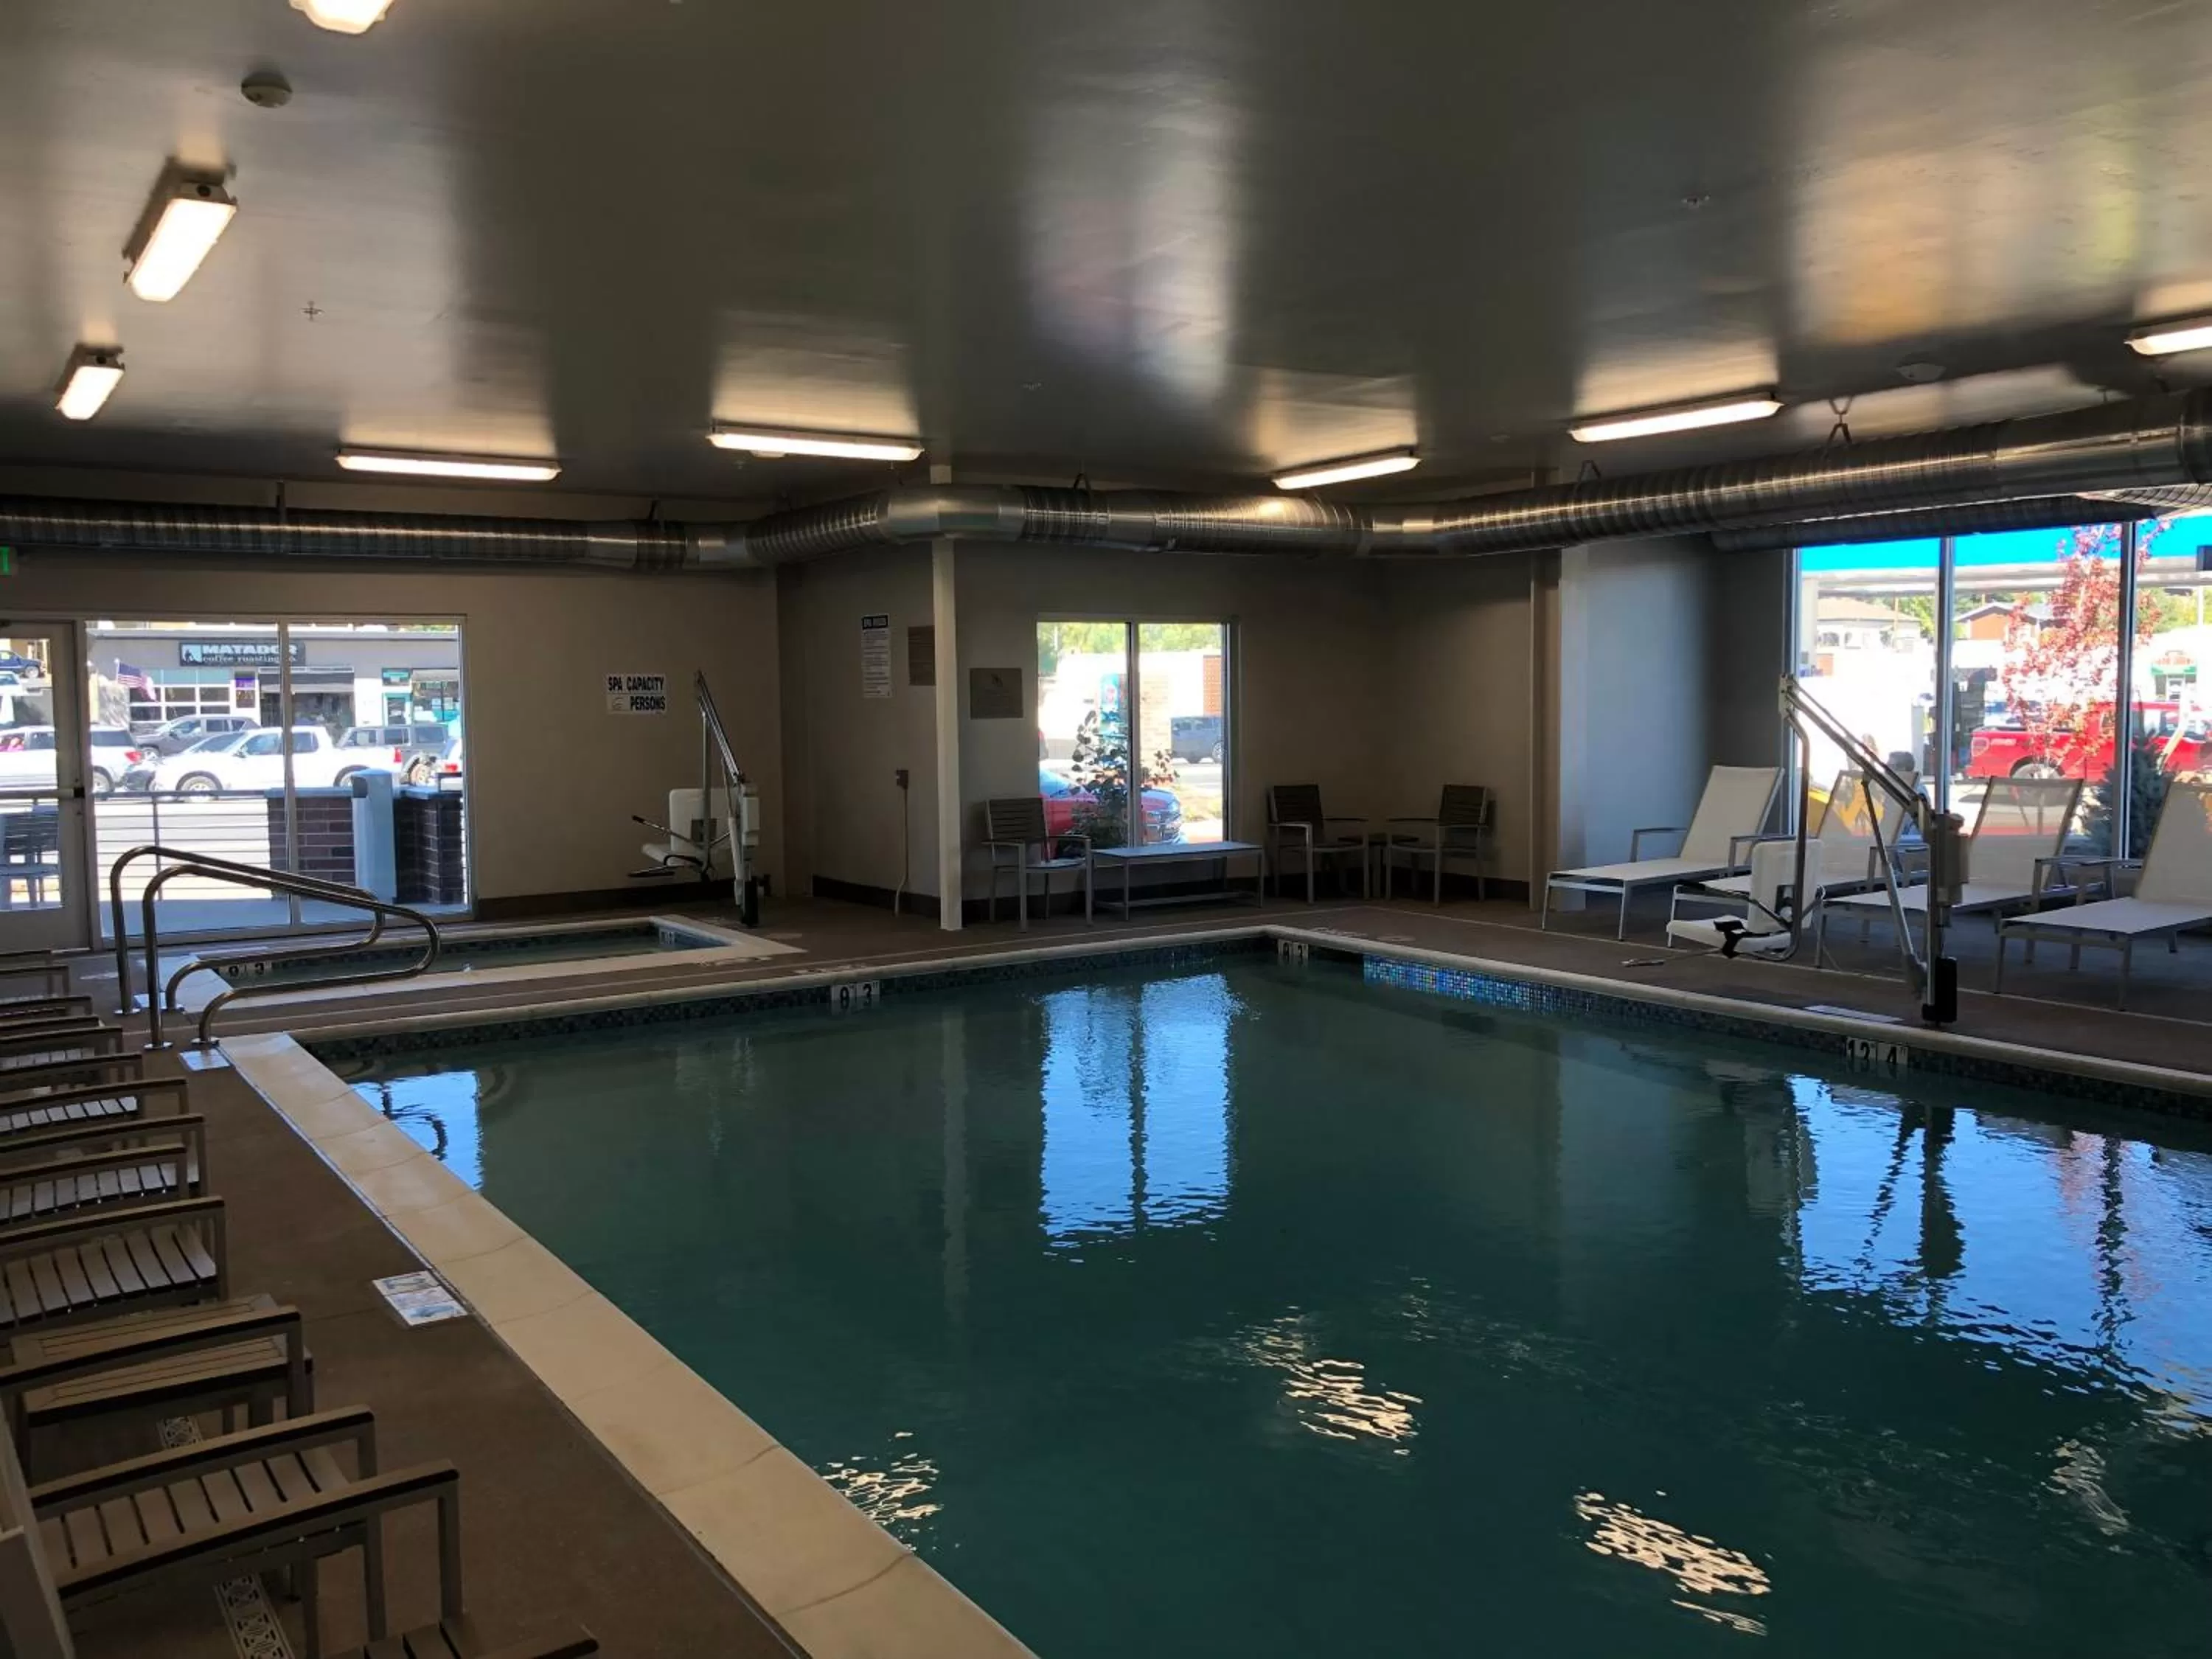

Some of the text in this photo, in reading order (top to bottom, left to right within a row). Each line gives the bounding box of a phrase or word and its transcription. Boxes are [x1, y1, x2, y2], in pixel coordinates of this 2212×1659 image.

[608, 676, 664, 690] SPA CAPACITY
[630, 696, 665, 710] PERSONS
